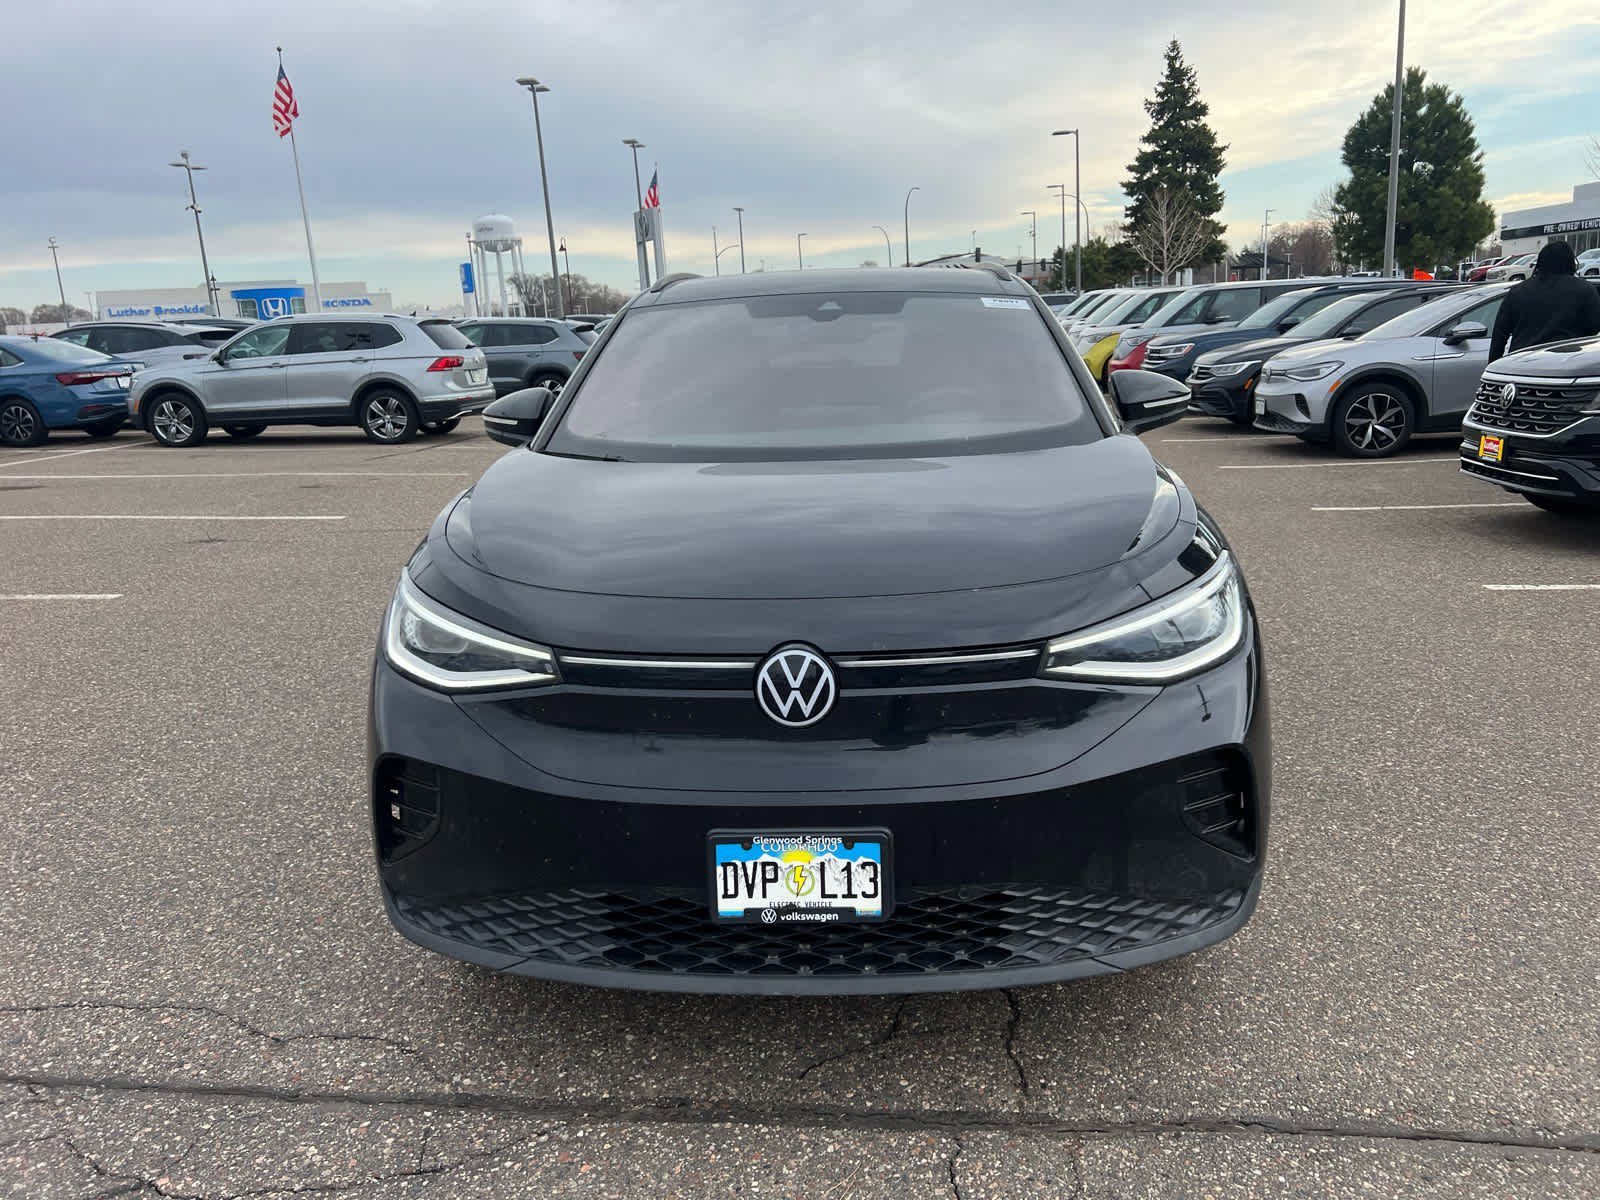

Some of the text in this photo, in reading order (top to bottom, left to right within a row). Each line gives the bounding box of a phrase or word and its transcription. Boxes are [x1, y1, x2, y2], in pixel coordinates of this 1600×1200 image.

[1543, 219, 1600, 233] PRE-OWNED VEHIC
[323, 297, 372, 307] HONDA
[108, 304, 206, 317] Luther Brookda
[752, 835, 842, 846] Glenwood Springs
[761, 841, 838, 852] COLORADO
[720, 861, 879, 899] DVP L13
[804, 901, 832, 909] VEHICLE
[780, 912, 839, 922] volkswagen
